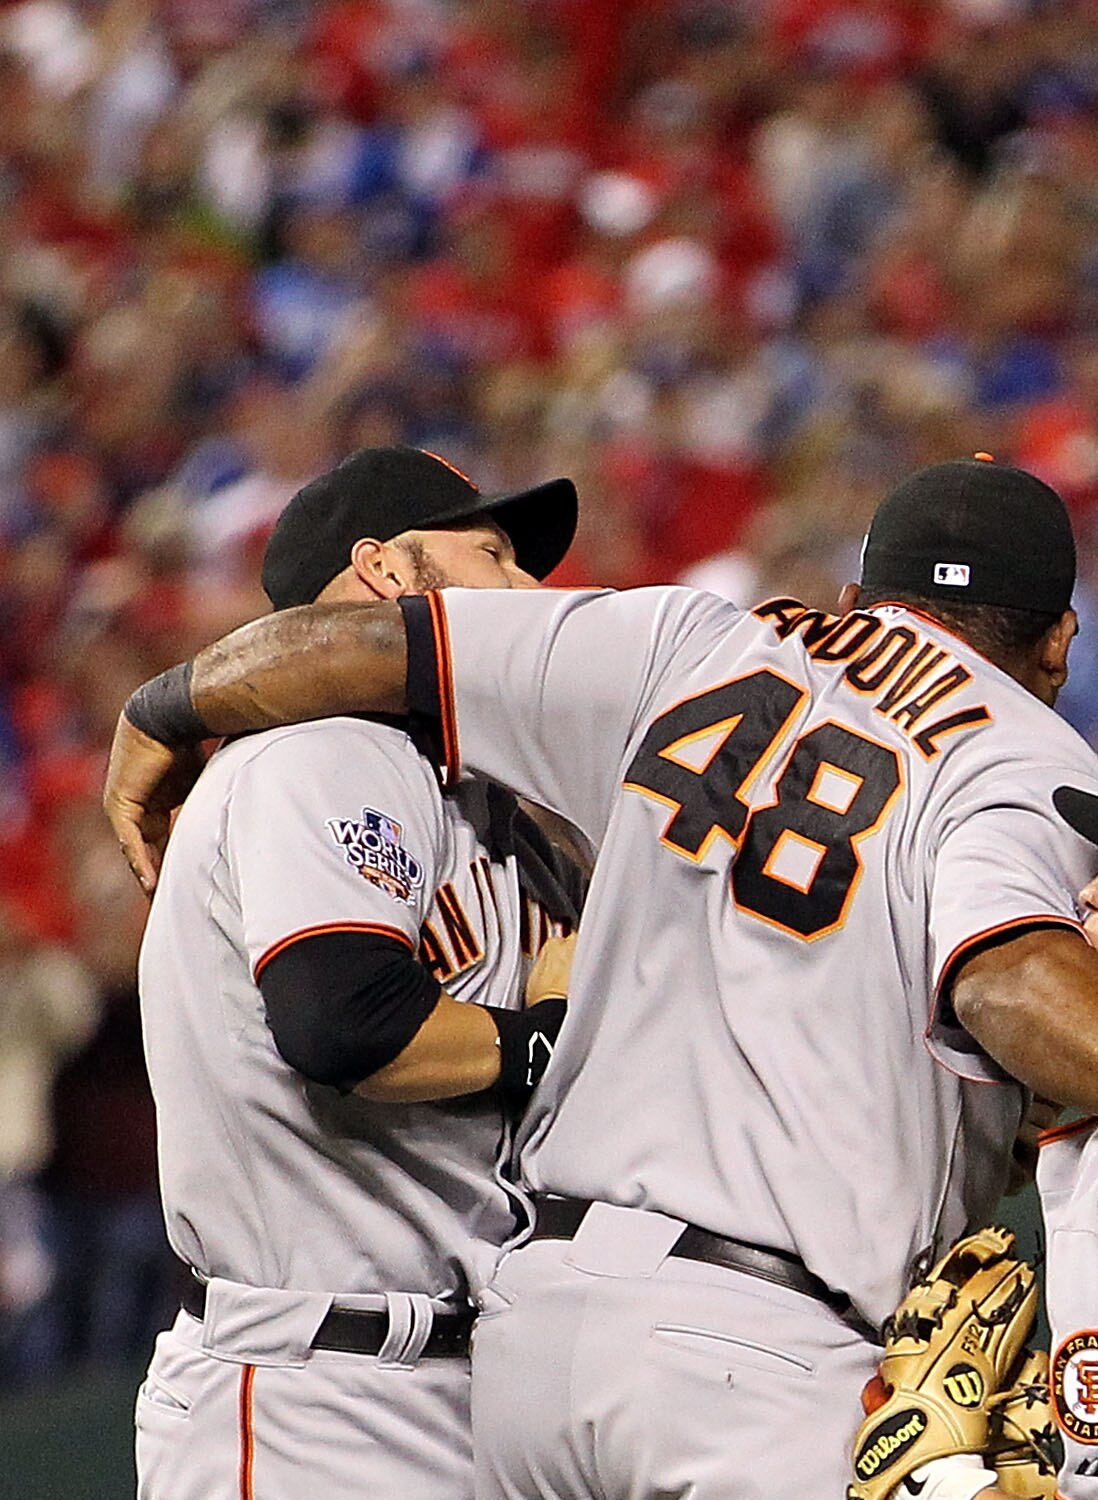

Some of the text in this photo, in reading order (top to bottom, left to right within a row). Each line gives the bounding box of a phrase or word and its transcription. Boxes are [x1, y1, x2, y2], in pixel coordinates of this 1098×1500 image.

[752, 597, 993, 761] ANDOVAL
[623, 667, 904, 942] 48
[327, 818, 421, 886] WORLD
[346, 842, 410, 893] SERIES
[857, 1414, 925, 1476] Wilson
